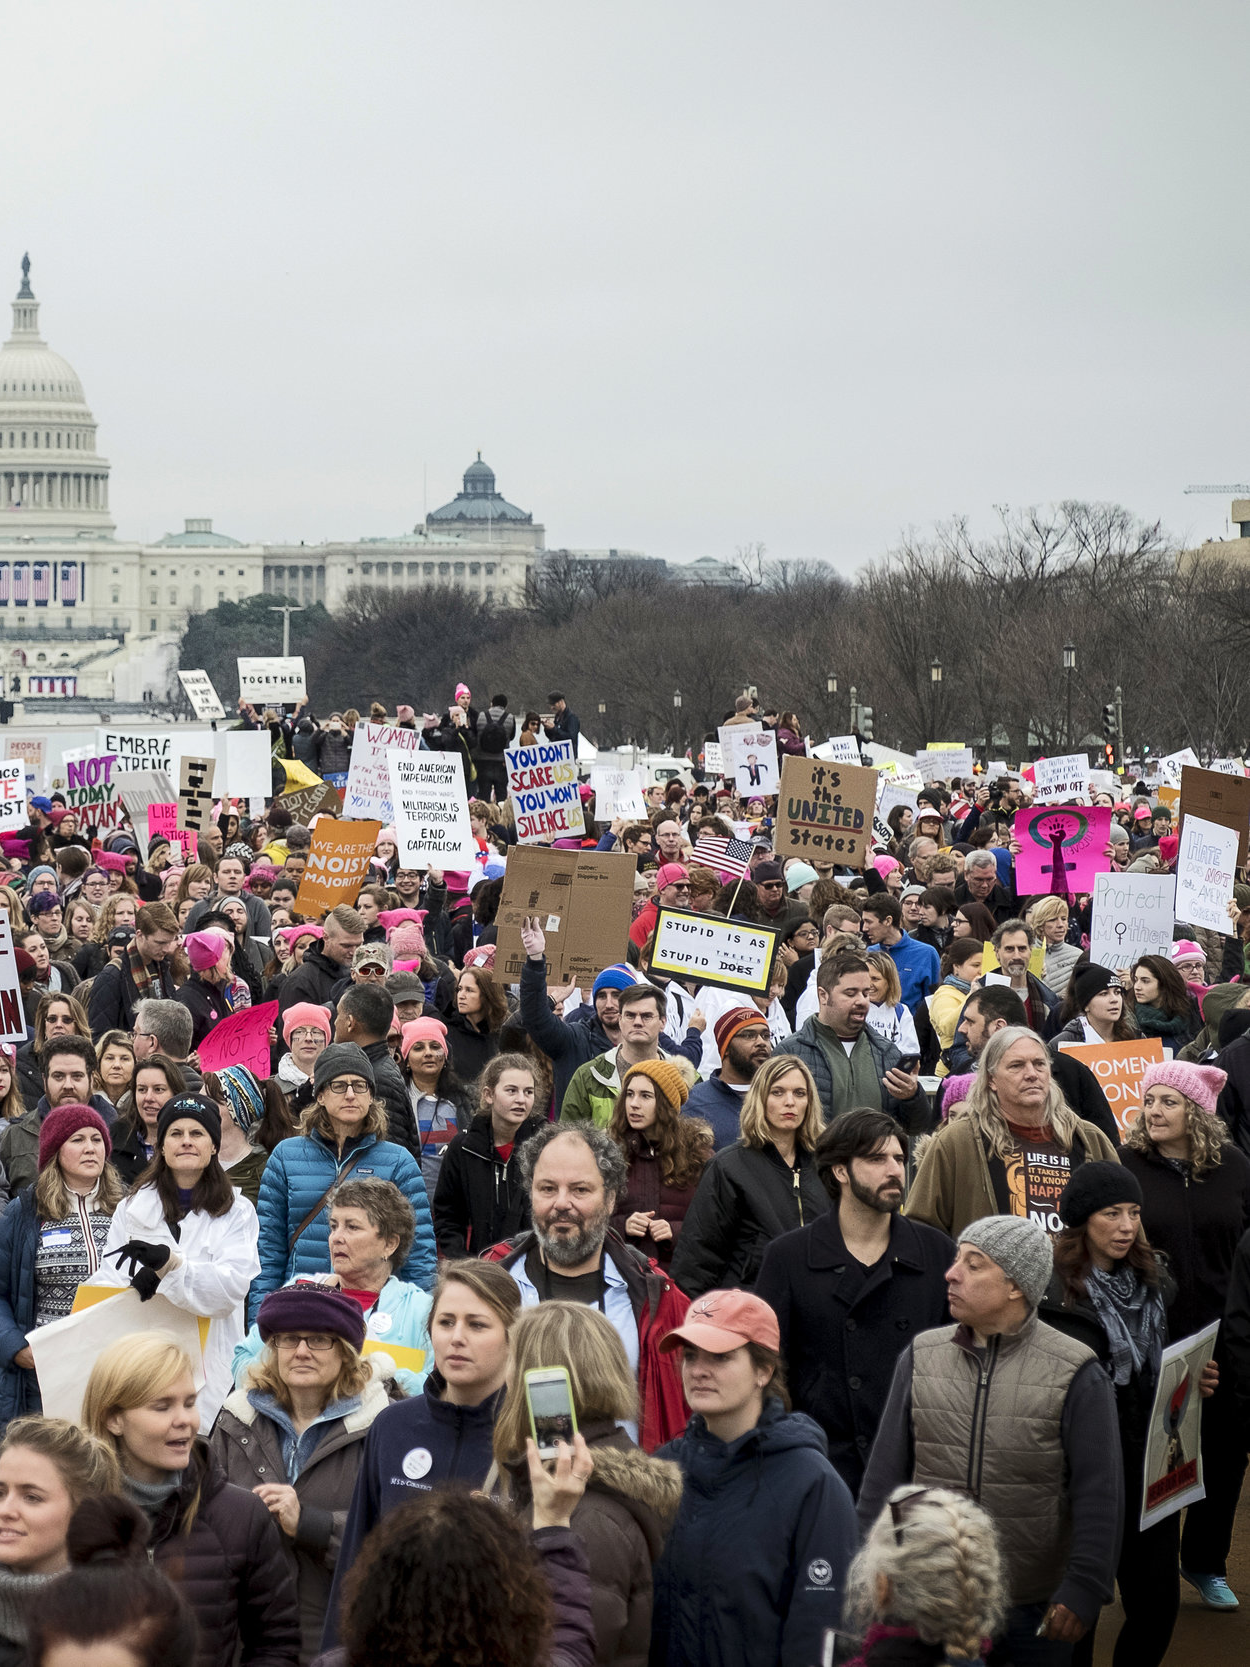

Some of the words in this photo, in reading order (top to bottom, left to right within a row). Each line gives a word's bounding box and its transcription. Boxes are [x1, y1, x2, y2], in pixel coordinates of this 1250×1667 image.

[242, 676, 302, 684] TOGETHER
[10, 742, 42, 750] PEOPLE
[367, 725, 417, 750] WOMEN
[506, 749, 538, 770] YOU
[538, 743, 570, 764] DON'T
[67, 755, 118, 789] NOT
[398, 762, 415, 772] END
[418, 763, 456, 774] AMERICAN
[511, 766, 554, 792] SCARE
[553, 763, 574, 783] US
[812, 766, 841, 788] it's
[401, 773, 453, 784] IMPERIALISM
[1054, 783, 1067, 793] YOU
[1070, 781, 1084, 791] OFF
[67, 783, 115, 806] TODAY
[351, 795, 371, 808] YOU
[516, 792, 546, 814] YOU
[545, 783, 578, 806] WON'T
[812, 786, 842, 806] the
[402, 800, 447, 812] MILITARISM
[450, 802, 459, 812] IS
[788, 798, 864, 829] UNITED
[405, 811, 458, 823] TERRORISM
[517, 808, 569, 838] SILENCE
[567, 806, 584, 828] US
[421, 828, 445, 839] END
[313, 840, 334, 853] WE
[335, 842, 356, 855] ARE
[358, 843, 375, 853] THE
[407, 840, 462, 852] CAPITALISM
[1188, 830, 1222, 866] HATE
[307, 854, 371, 873] NOISY
[305, 872, 363, 888] MAJORITY
[1205, 867, 1231, 888] NOT
[1097, 877, 1167, 909] Protect
[665, 920, 714, 938] STUPID
[727, 933, 741, 943] IS
[749, 938, 766, 949] AS
[660, 949, 709, 966] STUPID
[718, 960, 754, 976] DOES
[716, 950, 761, 964] TWEETS
[220, 1033, 250, 1062] NOT
[1027, 1152, 1048, 1163] LIFE
[1049, 1155, 1059, 1164] IS
[1028, 1174, 1041, 1183] TO
[1043, 1178, 1068, 1186] KNOW
[1037, 1168, 1060, 1176] TAKES
